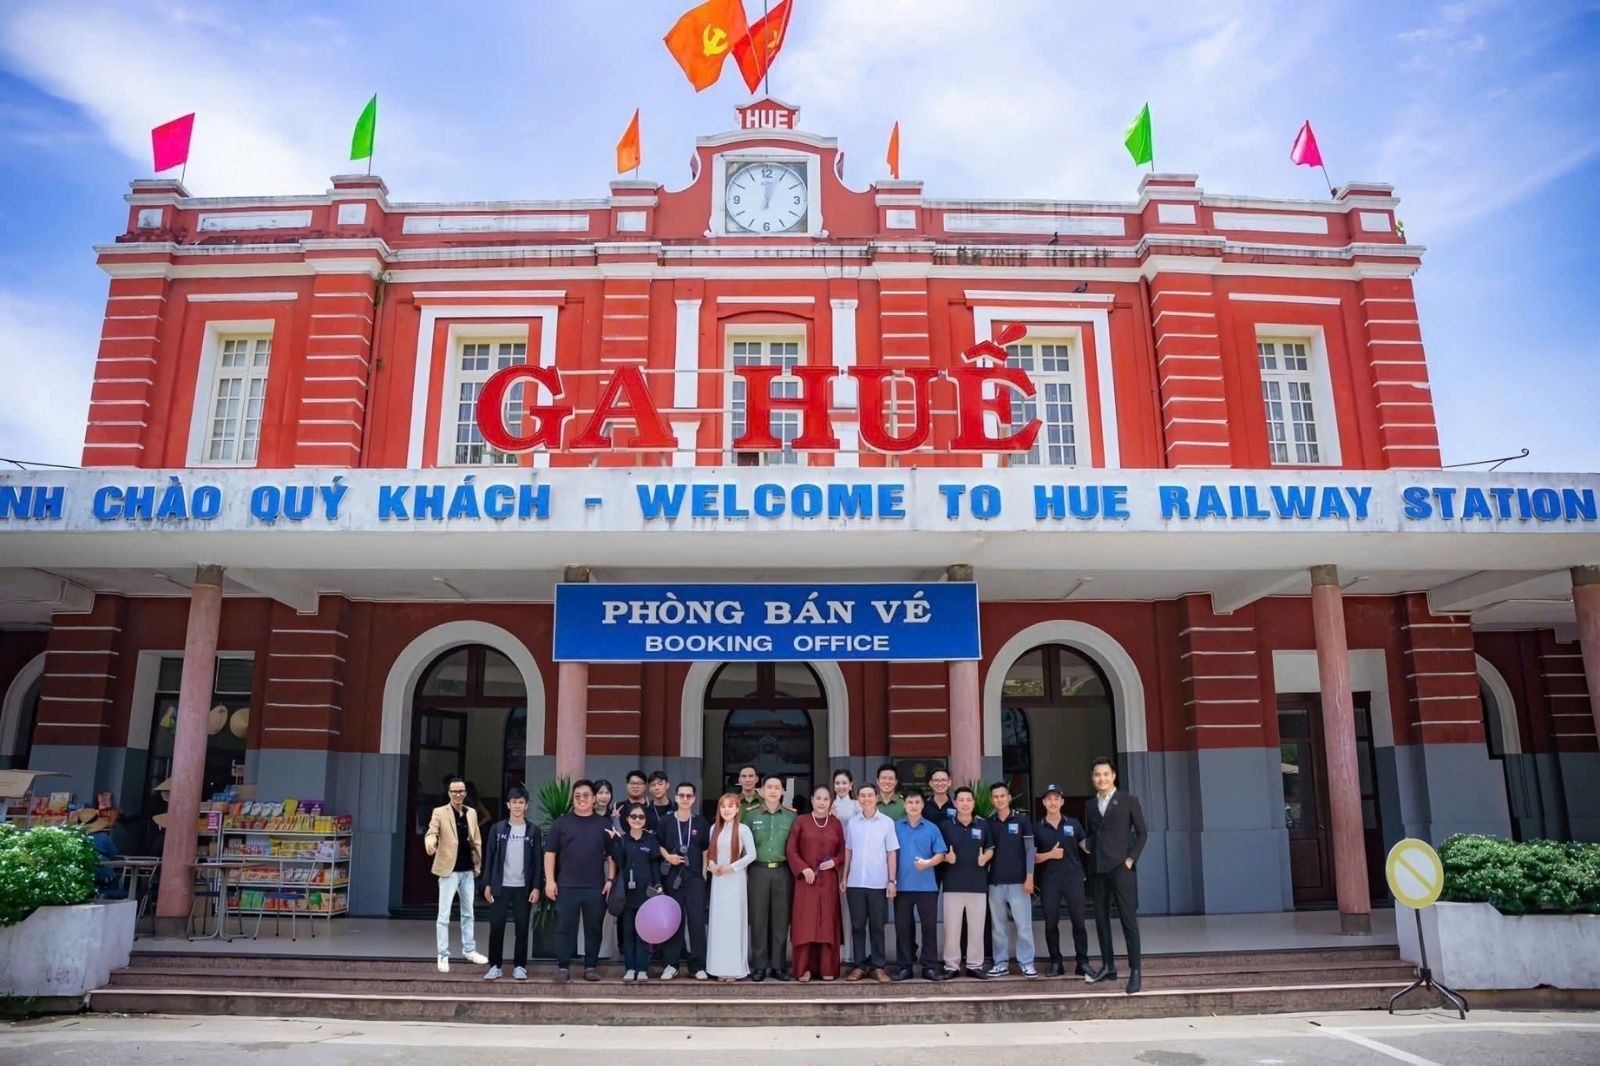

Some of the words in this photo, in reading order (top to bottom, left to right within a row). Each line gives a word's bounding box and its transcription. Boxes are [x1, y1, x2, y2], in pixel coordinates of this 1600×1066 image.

[746, 110, 788, 128] HUE
[761, 169, 773, 178] 12
[733, 195, 741, 205] 9
[793, 195, 801, 205] 3
[762, 222, 771, 231] 6
[476, 364, 678, 454] GA
[733, 323, 1043, 454] HUẾ
[93, 475, 223, 521] CHÀO
[250, 475, 349, 525] QUÝ
[378, 475, 551, 521] KHÁCH
[636, 483, 906, 520] WELCOME
[939, 484, 1003, 520] TO
[1033, 484, 1131, 520] HUE
[1159, 485, 1373, 521] RAILWAY
[1401, 486, 1598, 521] STATION
[601, 592, 745, 625] PHÒNG
[764, 592, 855, 625] BÁN
[871, 591, 932, 624] VÉ
[645, 635, 773, 652] BOOKING
[793, 635, 890, 652] OFFICE
